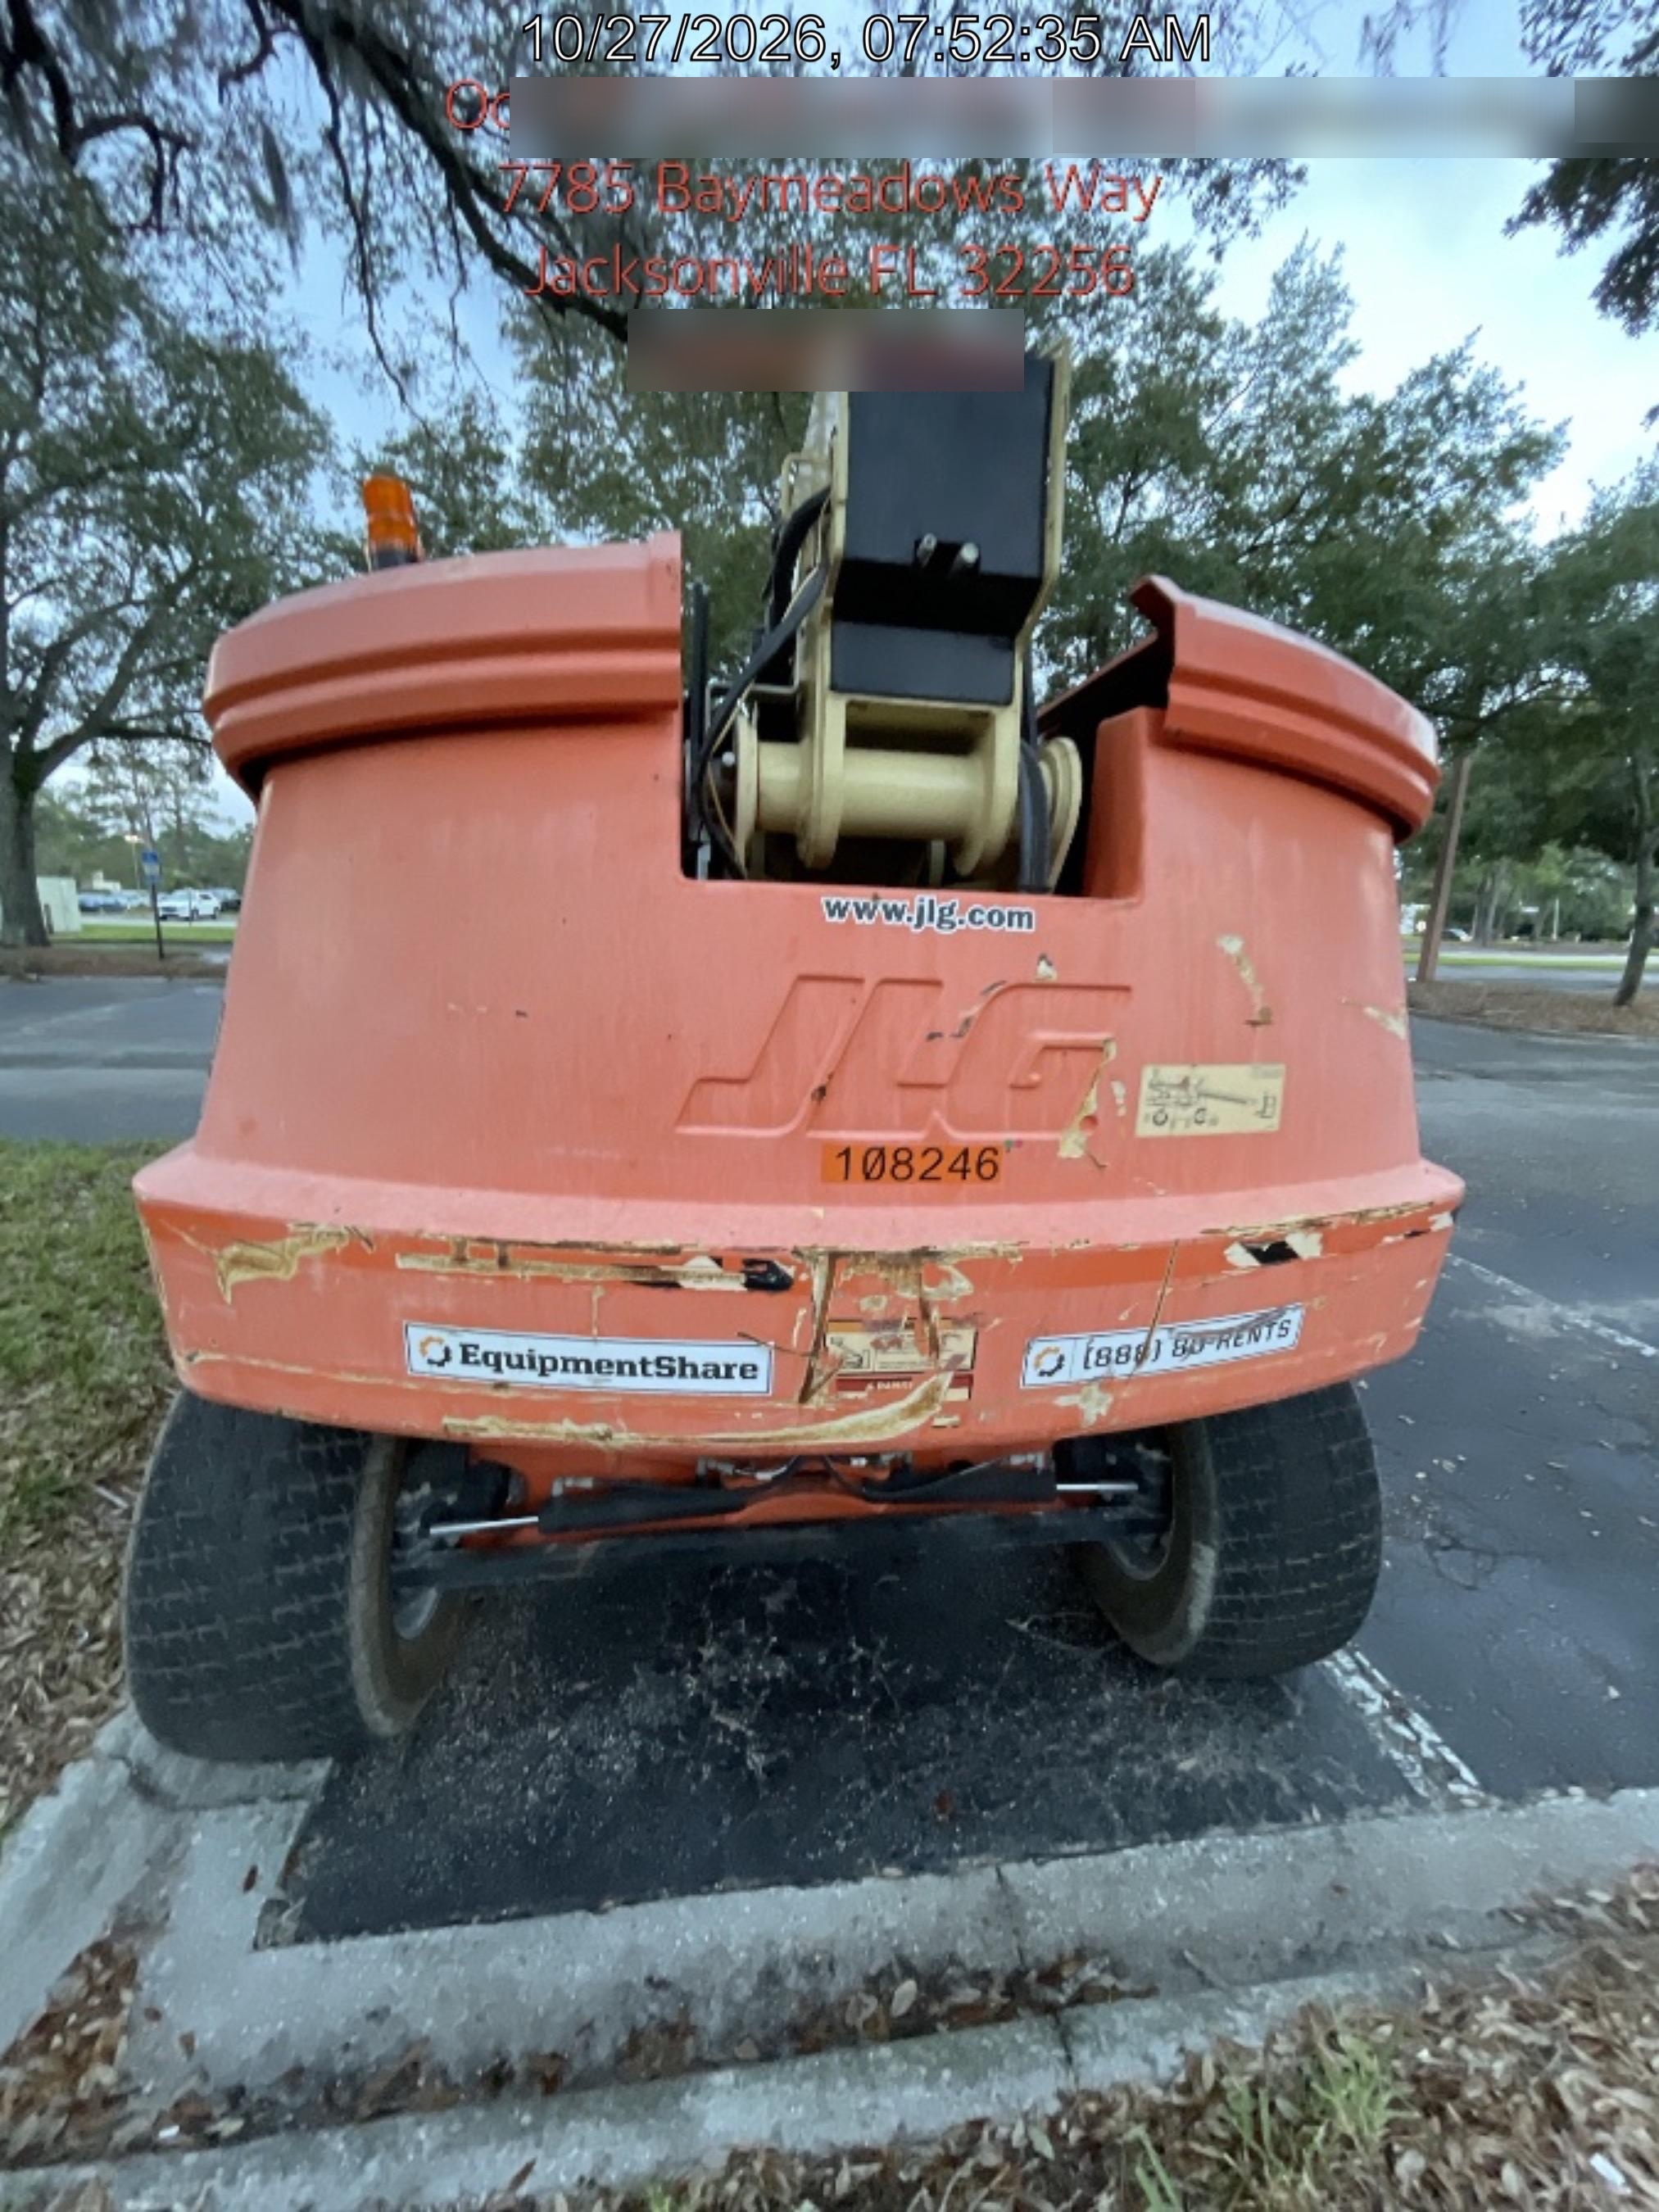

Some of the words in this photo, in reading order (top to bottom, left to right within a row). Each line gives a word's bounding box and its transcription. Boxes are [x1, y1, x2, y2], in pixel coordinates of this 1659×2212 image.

[823, 896, 1035, 931] www.jlg.com
[675, 975, 1132, 1140] JLG
[835, 1146, 999, 1181] 108246
[459, 1343, 759, 1380] EquipmentShare
